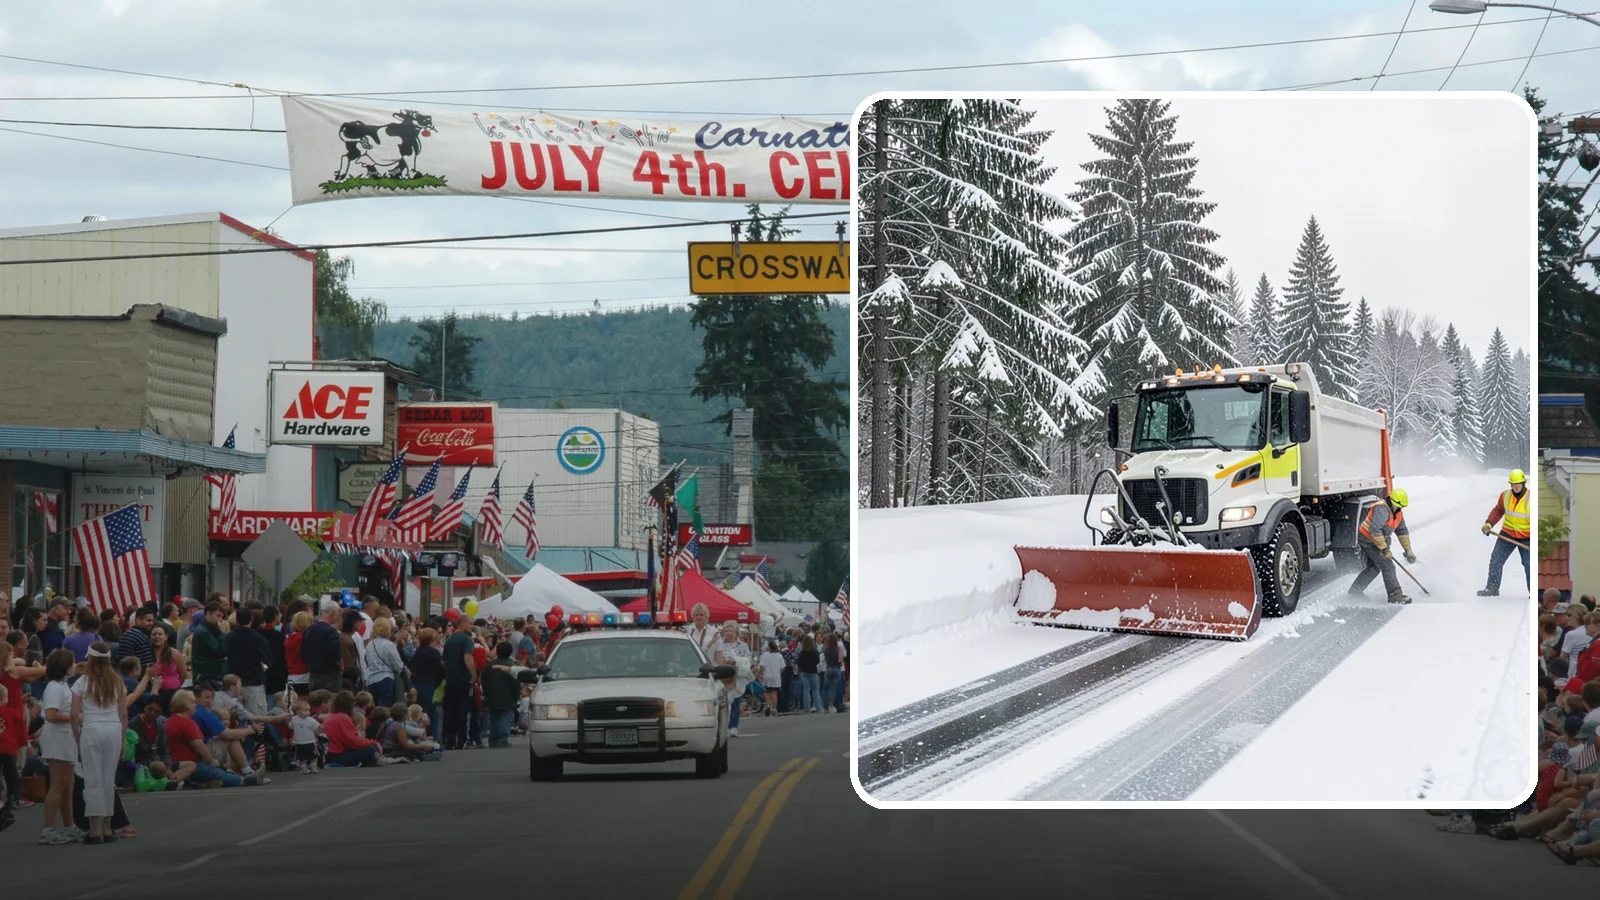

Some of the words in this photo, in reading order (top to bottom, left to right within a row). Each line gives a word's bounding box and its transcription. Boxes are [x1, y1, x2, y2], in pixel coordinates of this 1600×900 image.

[695, 121, 850, 150] Carnat
[481, 141, 605, 193] JULY
[632, 150, 747, 198] 4th.
[697, 254, 850, 280] CROSSWA
[282, 380, 374, 420] ACE
[405, 409, 453, 423] CEDAR
[283, 420, 371, 437] Hardware
[353, 466, 385, 480] Simpl
[95, 484, 124, 495] Vincent
[126, 486, 136, 495] de
[138, 486, 155, 496] Paul
[213, 516, 330, 535] HARDARE
[688, 526, 741, 535] CRNATION
[699, 535, 730, 543] GLASS
